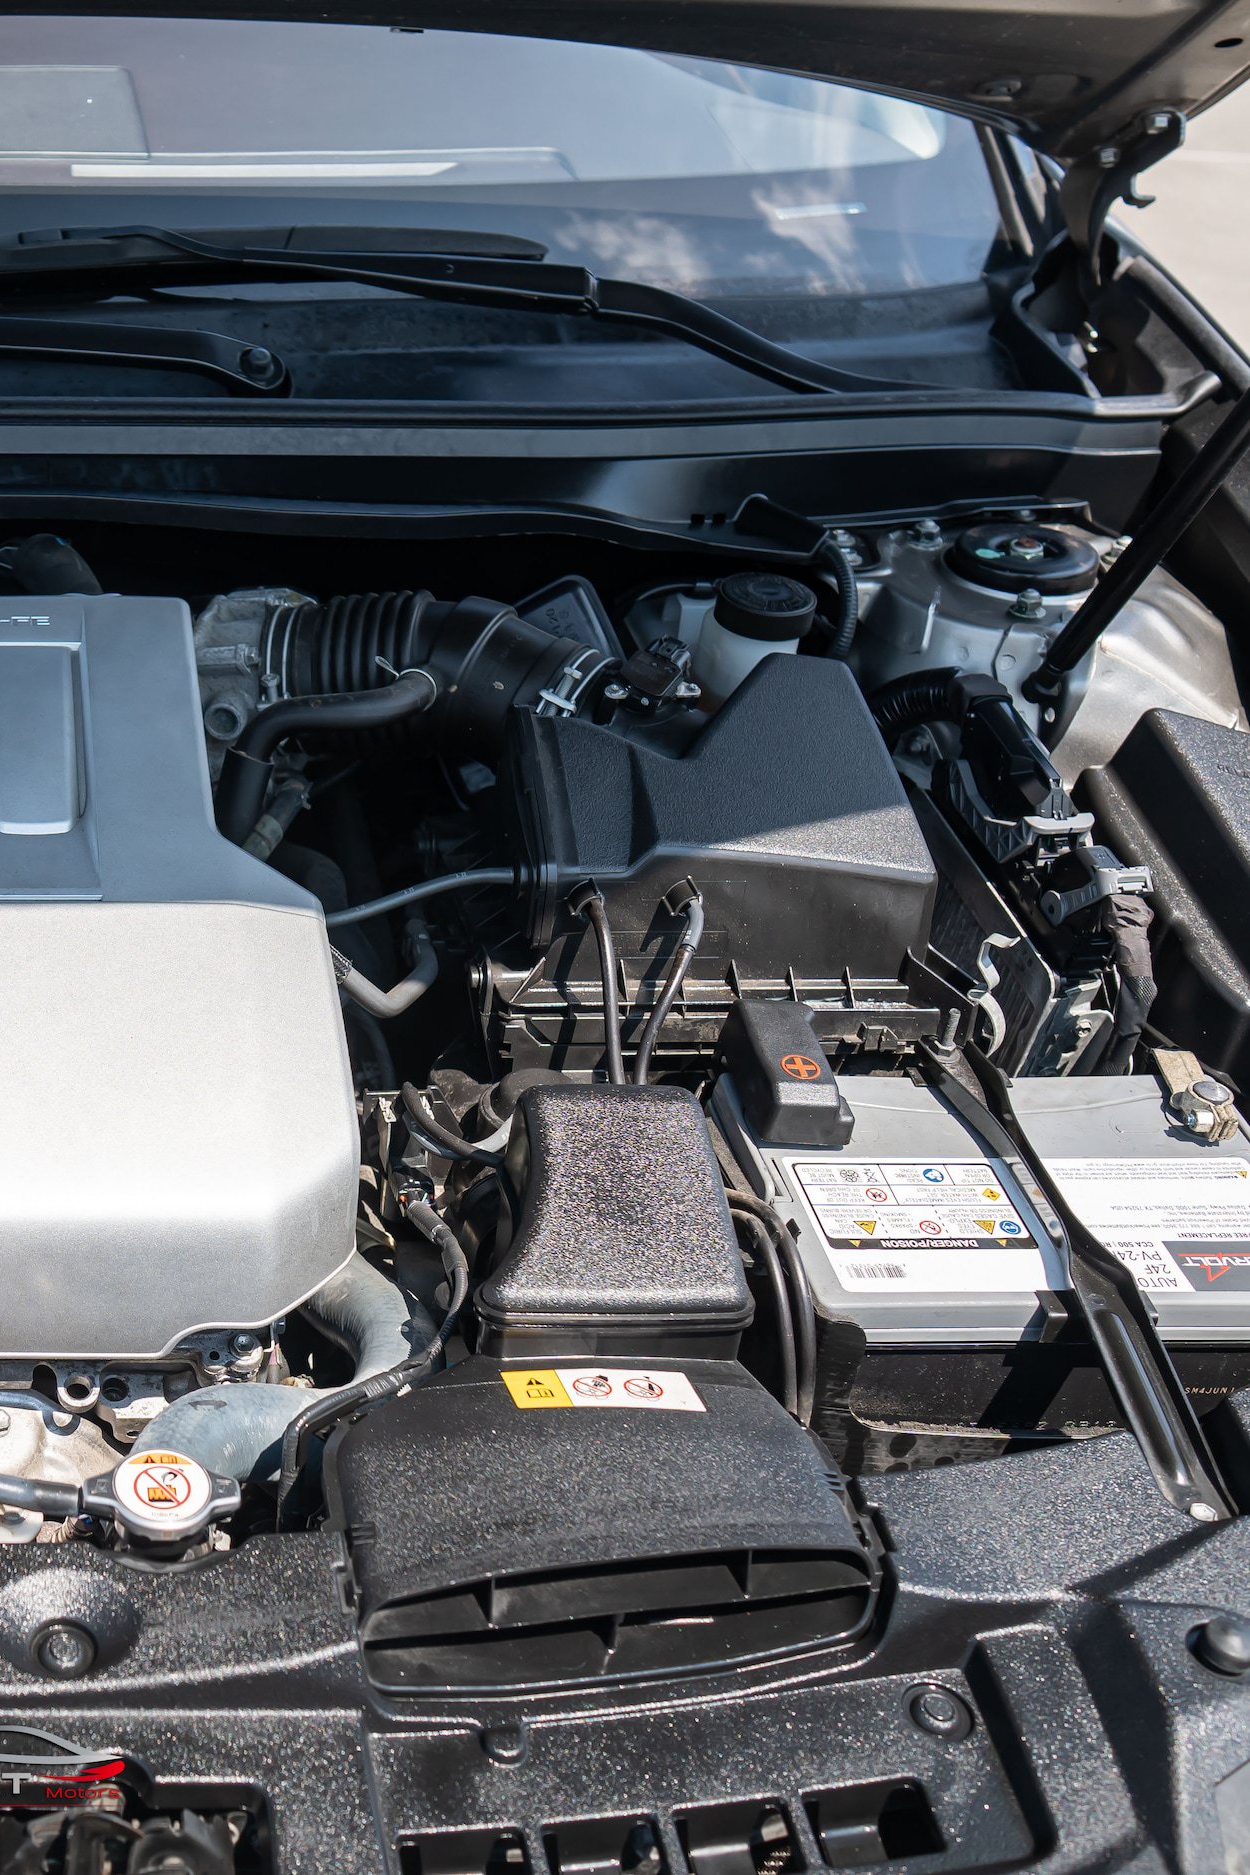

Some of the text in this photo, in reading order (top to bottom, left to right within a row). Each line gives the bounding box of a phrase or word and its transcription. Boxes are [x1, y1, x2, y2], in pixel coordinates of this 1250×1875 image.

[880, 1239, 979, 1248] DANGER/POISON
[1144, 1264, 1171, 1274] 24F
[1137, 1277, 1178, 1288] AUTO
